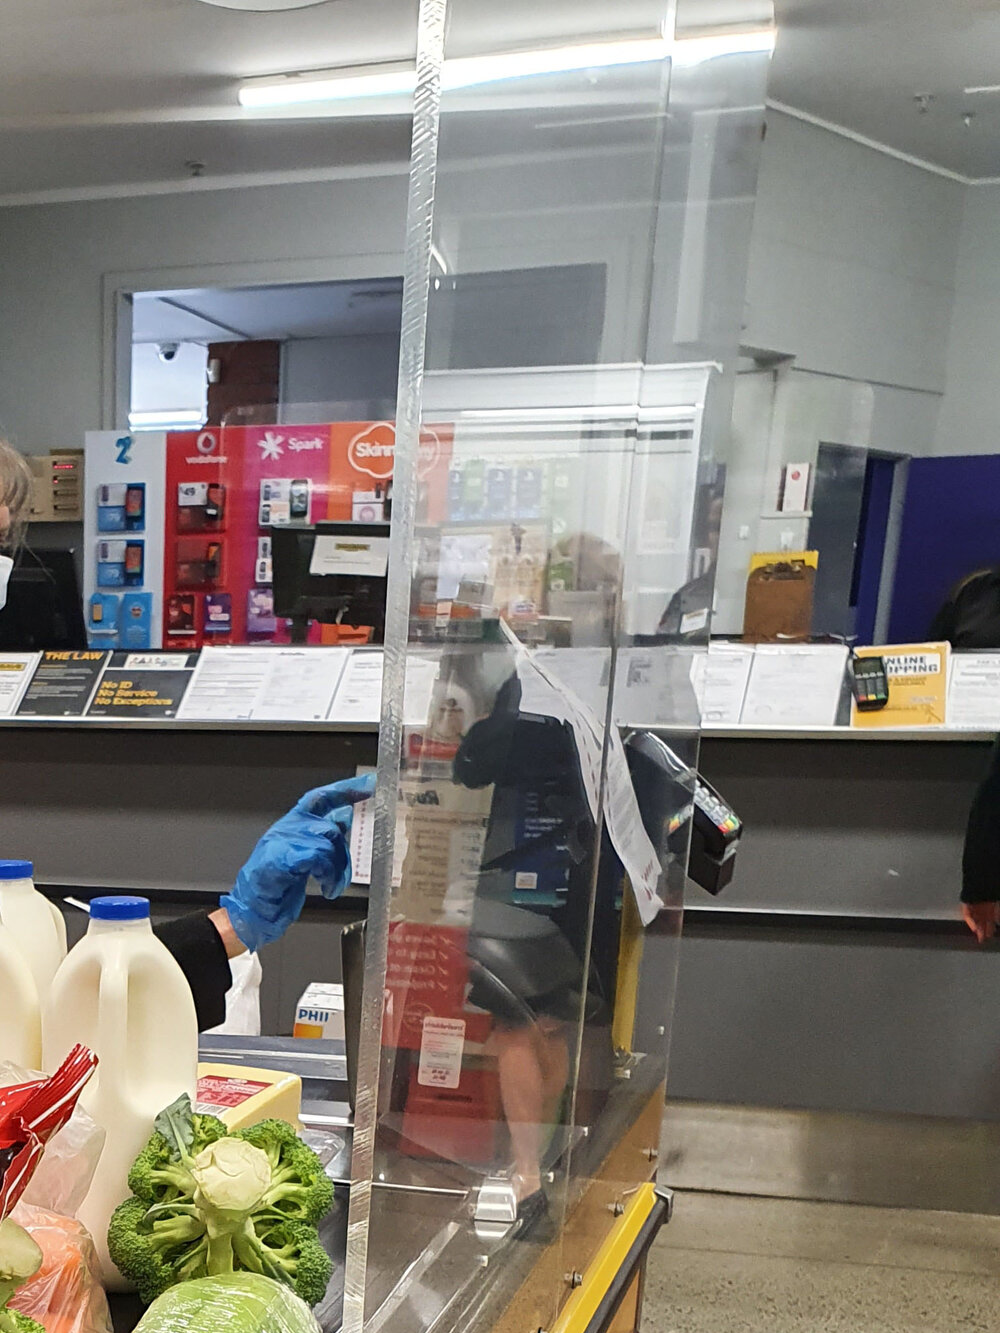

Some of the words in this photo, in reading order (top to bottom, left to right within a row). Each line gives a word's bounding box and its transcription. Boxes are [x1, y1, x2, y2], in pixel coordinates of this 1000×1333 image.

[288, 437, 325, 452] Spark
[44, 651, 70, 661] THE
[73, 651, 104, 661] LAW
[886, 656, 927, 665] NLINE
[101, 681, 118, 689] No
[119, 681, 133, 689] ID
[98, 689, 115, 697] No
[115, 689, 158, 697] Service
[94, 697, 112, 705] No
[112, 698, 173, 706] Exceptions
